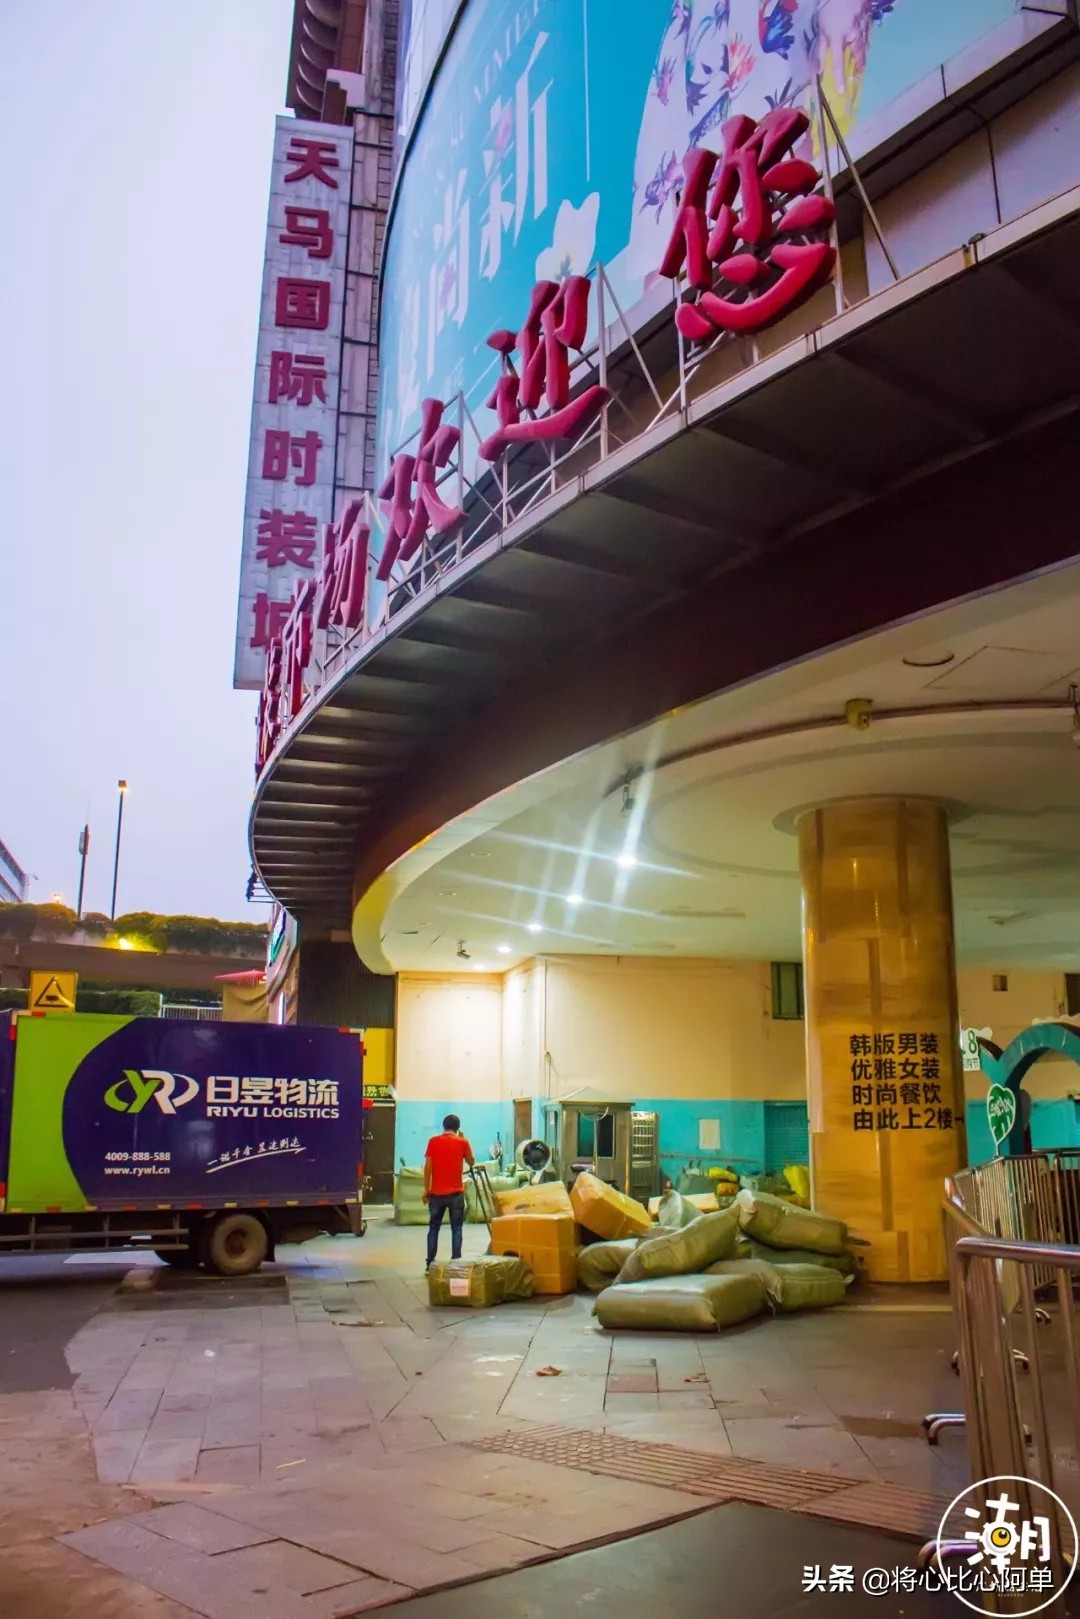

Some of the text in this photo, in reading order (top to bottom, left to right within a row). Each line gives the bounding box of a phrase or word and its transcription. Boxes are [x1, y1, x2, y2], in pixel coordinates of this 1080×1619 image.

[849, 1032, 938, 1056] 韩版男装
[851, 1058, 940, 1081] 优雅女装
[206, 1076, 340, 1106] 日昱物流
[852, 1082, 942, 1106] 时尚餐饮
[206, 1106, 340, 1119] RIYU LOGISTICS
[854, 1107, 953, 1131] 由此上2楼
[104, 1152, 171, 1162] 4009-888-588
[207, 1145, 253, 1165] 一诺千金
[104, 1166, 171, 1177] www.rywl.cn
